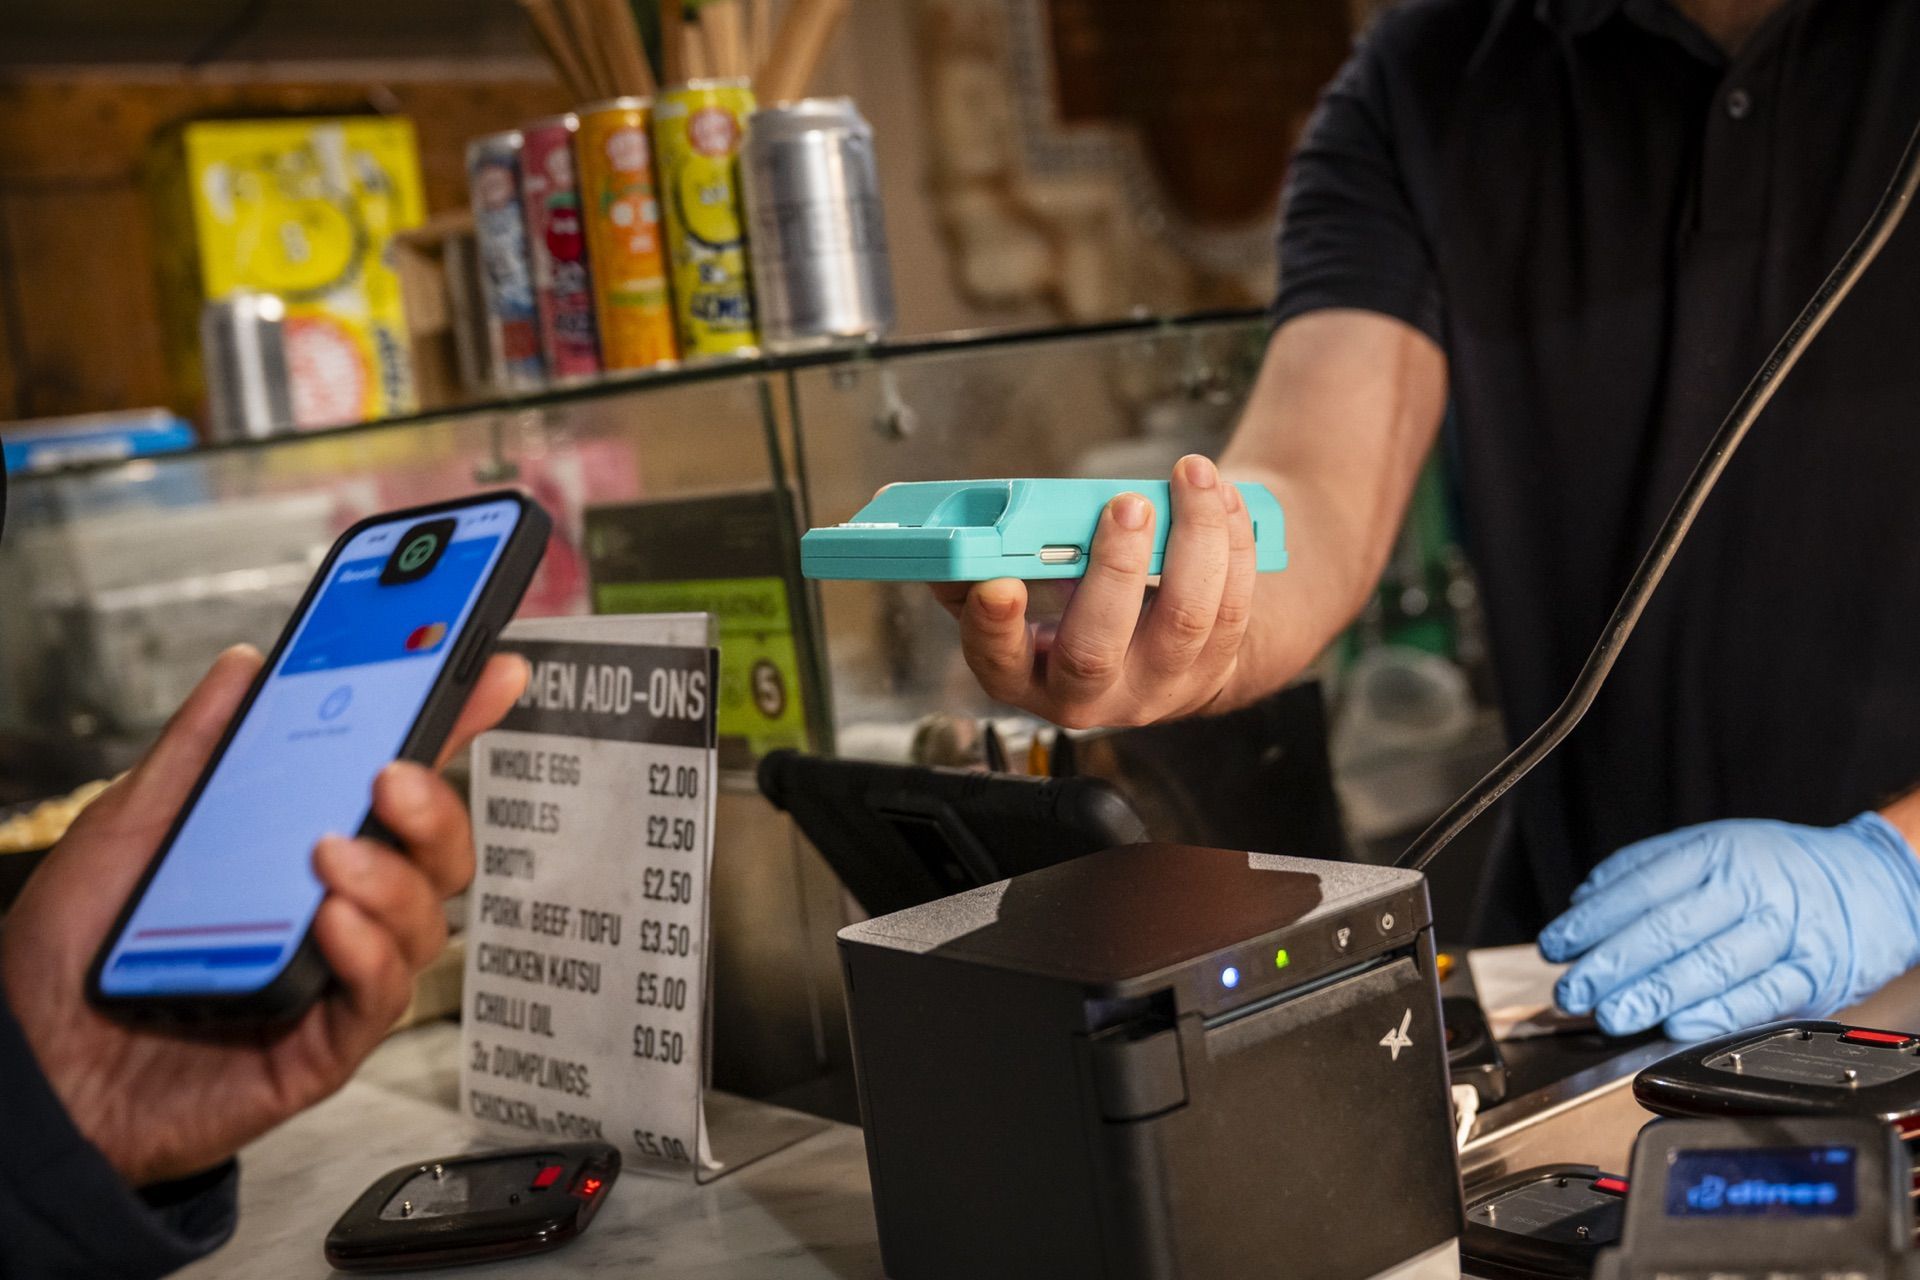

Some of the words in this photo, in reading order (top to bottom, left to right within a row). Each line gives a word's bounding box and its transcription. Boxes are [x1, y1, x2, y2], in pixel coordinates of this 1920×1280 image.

[517, 661, 577, 711] MEN
[582, 666, 706, 721] ADD-ONS
[490, 748, 543, 784] WHOLE
[550, 754, 581, 787] EGG
[648, 763, 698, 799] £2.00
[486, 797, 560, 834] NOODLES
[646, 815, 695, 852] £2.50
[484, 844, 535, 880] BROTH
[643, 867, 691, 904] £2.50
[481, 893, 523, 930] PORK
[531, 901, 570, 938] BEEF
[578, 908, 622, 946] TOFU
[640, 919, 690, 957] £3.50
[478, 942, 545, 984] CHICKEN
[548, 956, 601, 995] KATSU
[636, 971, 687, 1011] £5.00
[475, 991, 526, 1031] CHILLI
[529, 1002, 554, 1038] OIL
[633, 1024, 684, 1065] £0.50
[470, 1090, 539, 1132] CHICKEN
[634, 1129, 691, 1164] £5.00
